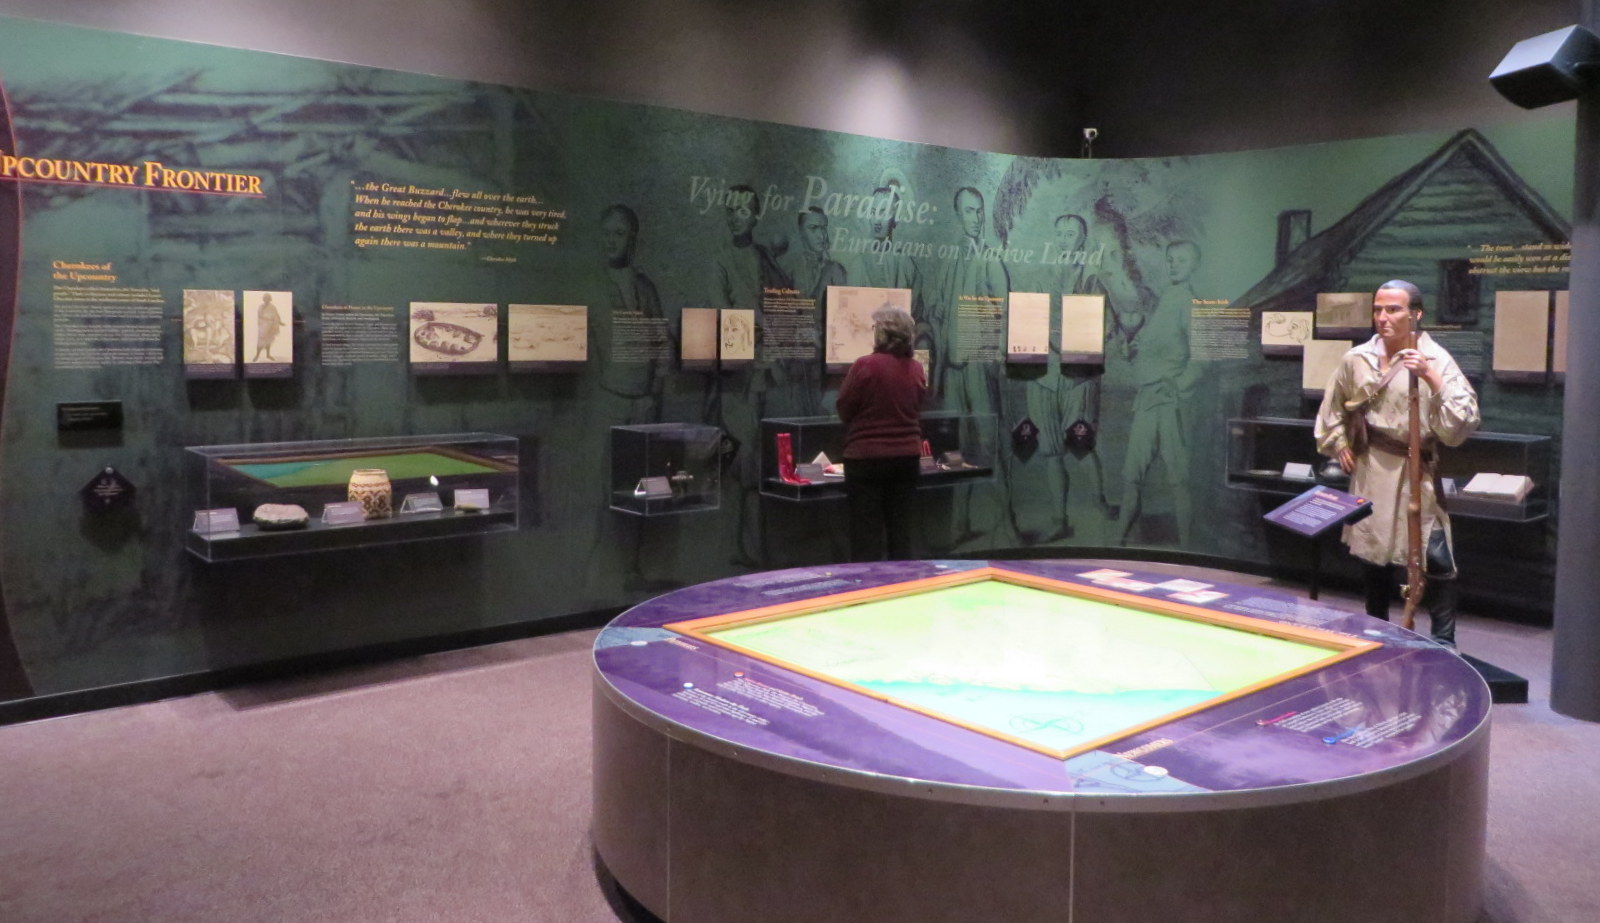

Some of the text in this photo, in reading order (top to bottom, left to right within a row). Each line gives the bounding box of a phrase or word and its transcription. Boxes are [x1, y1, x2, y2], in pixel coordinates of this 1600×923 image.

[0, 153, 263, 194] PCOUNTRY FRONTIER
[382, 183, 406, 193] Great
[471, 191, 483, 199] all
[502, 193, 514, 202] the
[688, 175, 938, 226] Vying for Paradise:
[355, 194, 380, 204] When
[381, 196, 390, 206] he
[392, 199, 422, 208] reached
[424, 200, 436, 209] the
[438, 201, 472, 212] Cherokee
[532, 210, 548, 220] very
[354, 209, 371, 218] and
[372, 209, 385, 218] his
[386, 211, 411, 223] wings
[412, 212, 436, 224] began
[486, 218, 520, 227] wherever
[522, 220, 536, 231] they
[354, 222, 368, 232] the
[370, 224, 392, 233] earth
[394, 224, 414, 234] there
[466, 229, 482, 238] and
[482, 230, 505, 240] where
[506, 232, 522, 244] they
[523, 234, 548, 242] turned
[354, 236, 378, 248] again
[380, 236, 401, 246] there
[404, 240, 419, 248] was
[830, 227, 1104, 266] Europeans on Native Land
